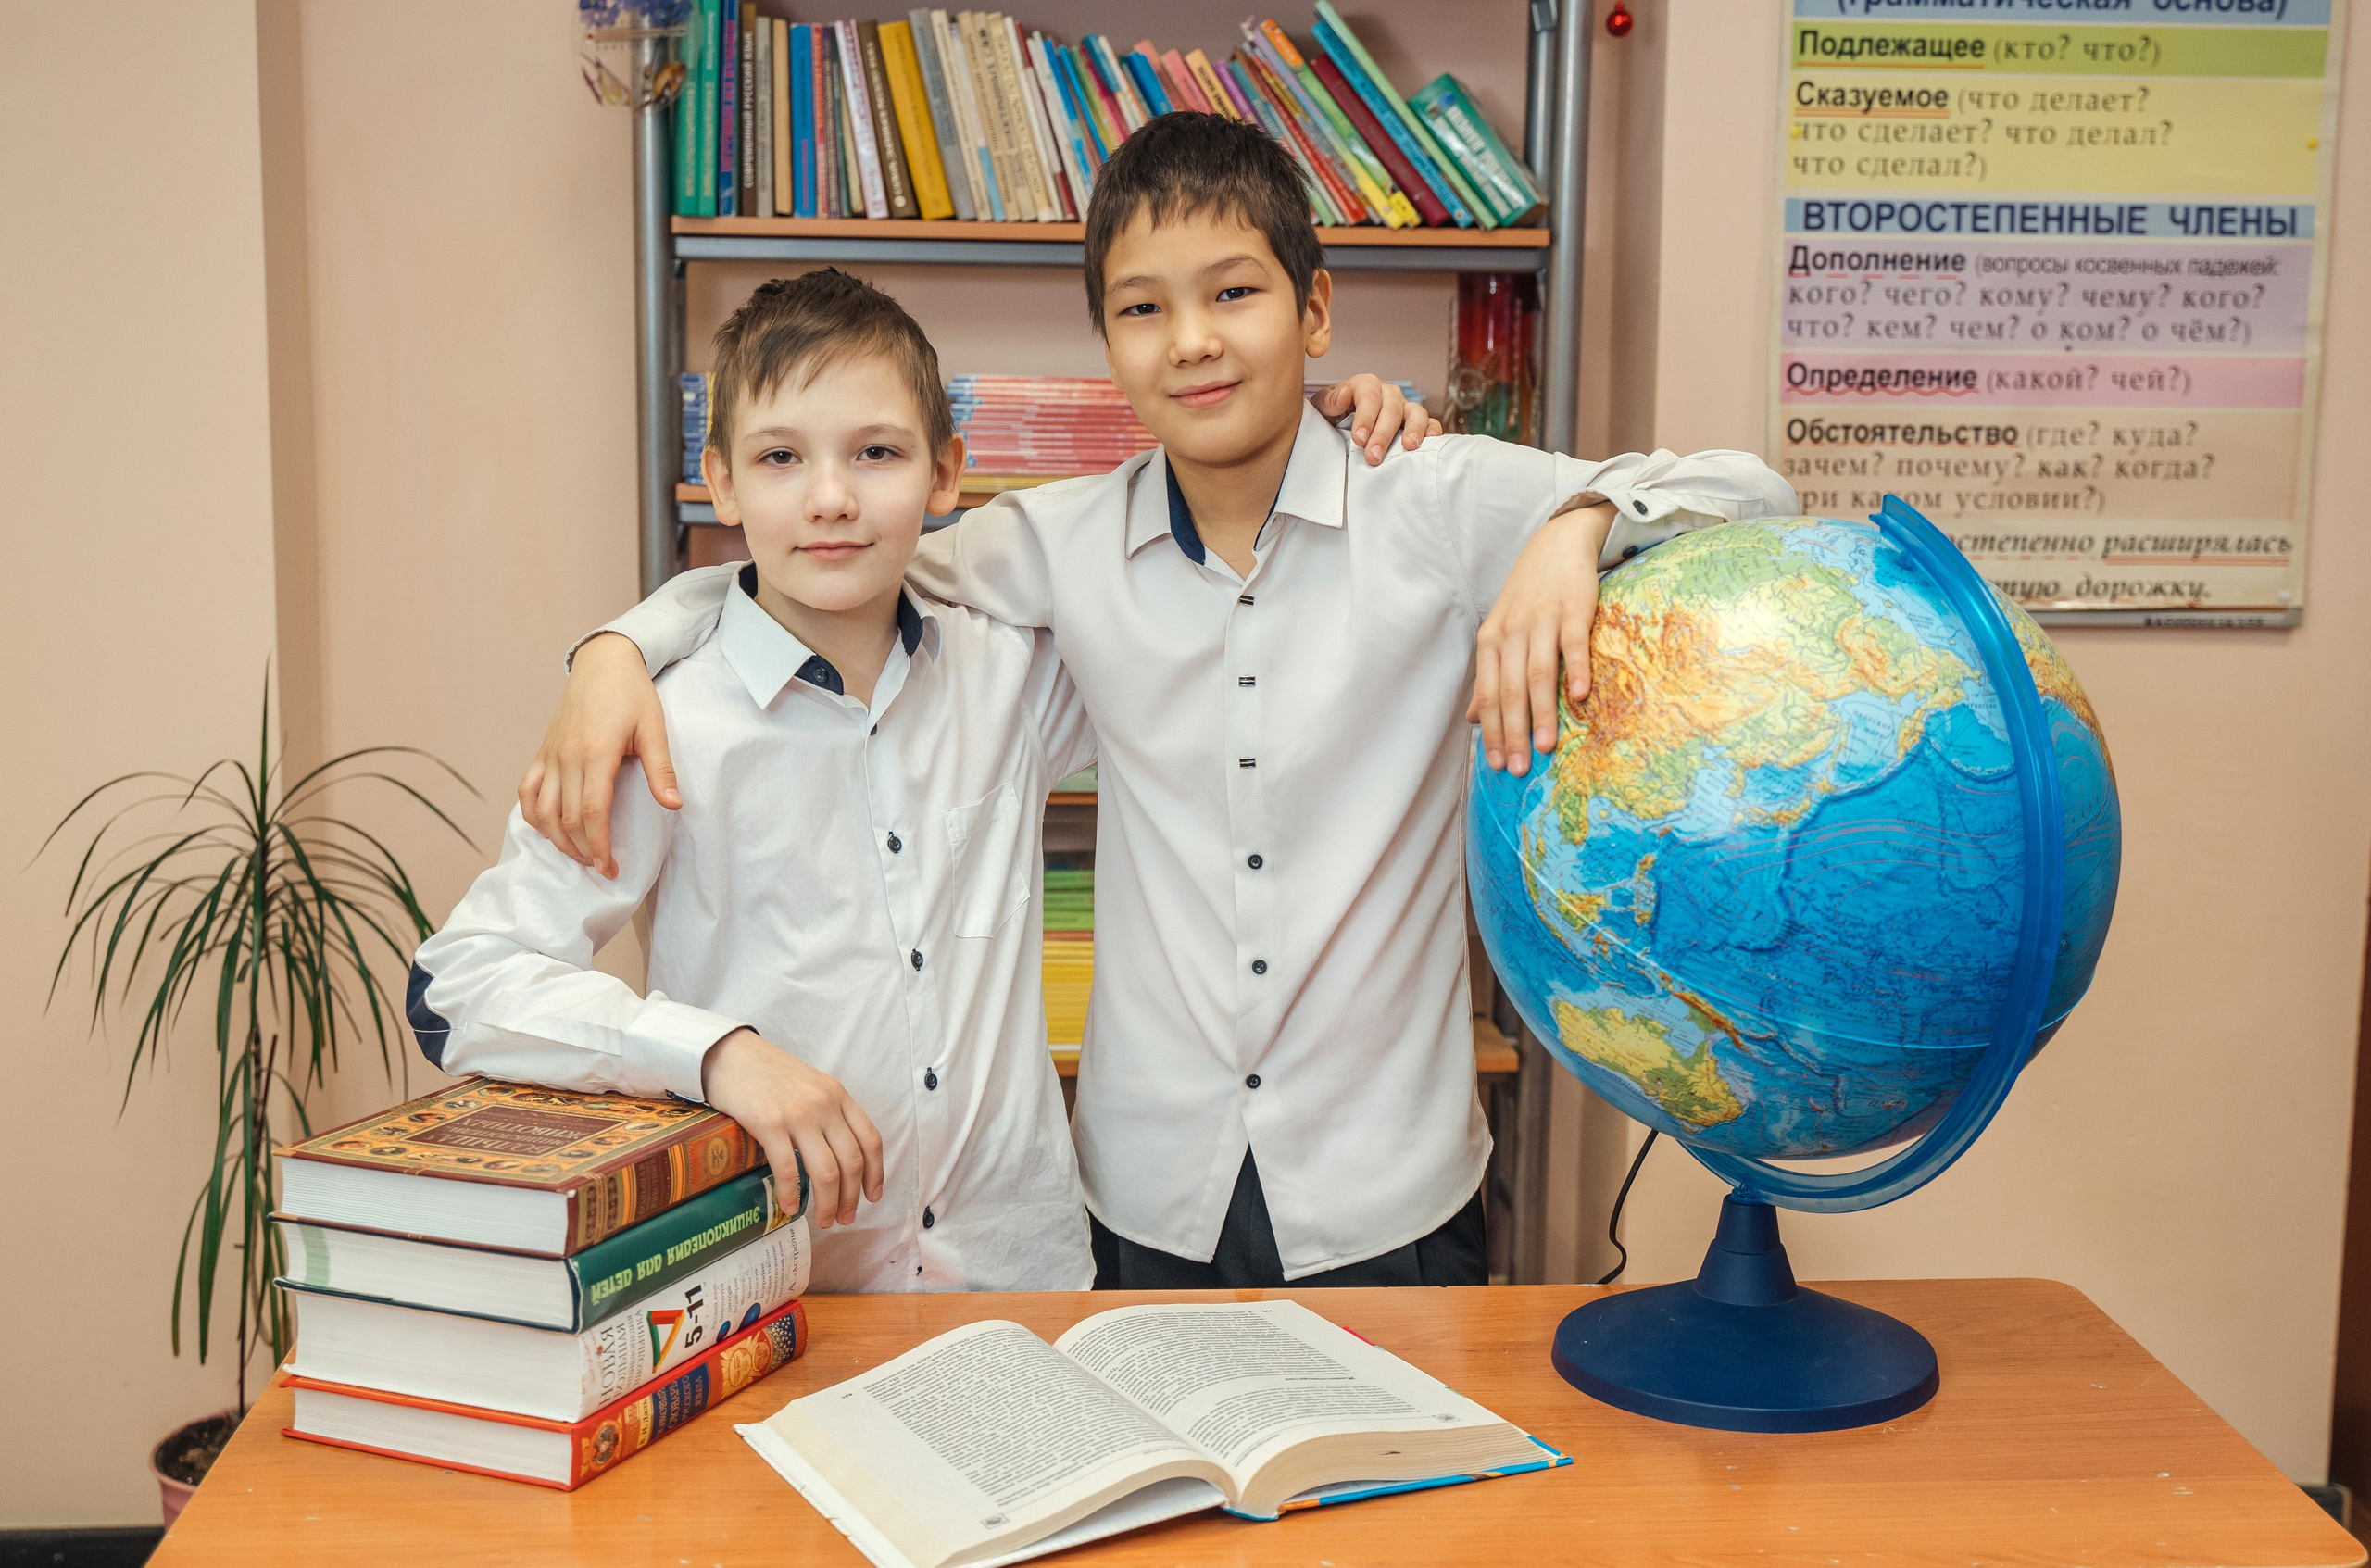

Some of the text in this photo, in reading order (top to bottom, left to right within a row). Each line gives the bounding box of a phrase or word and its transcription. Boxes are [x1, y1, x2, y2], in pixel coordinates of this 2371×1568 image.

[1800, 31, 2162, 68] Подлежащее (кто? что?)
[1797, 81, 2150, 115] Сказуемое (что делает?
[1857, 118, 1993, 144] сделает?
[2006, 124, 2057, 145] что
[2066, 119, 2173, 148] делал?
[1793, 150, 1988, 182] что сделал?)
[1803, 202, 2297, 237] ВТОРОСТЕПЕННЫЕ ЧЛЕНЫ
[1788, 245, 1965, 276] Дополнение
[1975, 251, 2068, 278] (вопросы
[2075, 257, 2182, 276] косвенных
[1788, 280, 2265, 317] кого? чего? кому? чему? кого?
[1788, 312, 2252, 348] что? кем? чем? о ком? о чём?)
[1787, 362, 2192, 397] Определение (какой? чей?)
[1787, 418, 2199, 456] Обстоятельство (где? куда?
[1783, 450, 2216, 487] зачем? почему? как? когда?
[1797, 484, 2106, 518] ри каом условии?)
[1946, 533, 2294, 559] степенно расширялась
[591, 1206, 760, 1307] ЭНЦИКЛОПЕДИЯ ДЛЯ ДЕТЕЙ
[684, 1284, 703, 1349] 5-11
[599, 1326, 616, 1406] НОВАЯ
[669, 1380, 681, 1428] СЛОВАРЬ
[681, 1375, 692, 1421] РУССКОГО
[695, 1375, 703, 1407] ЯЗЫКА
